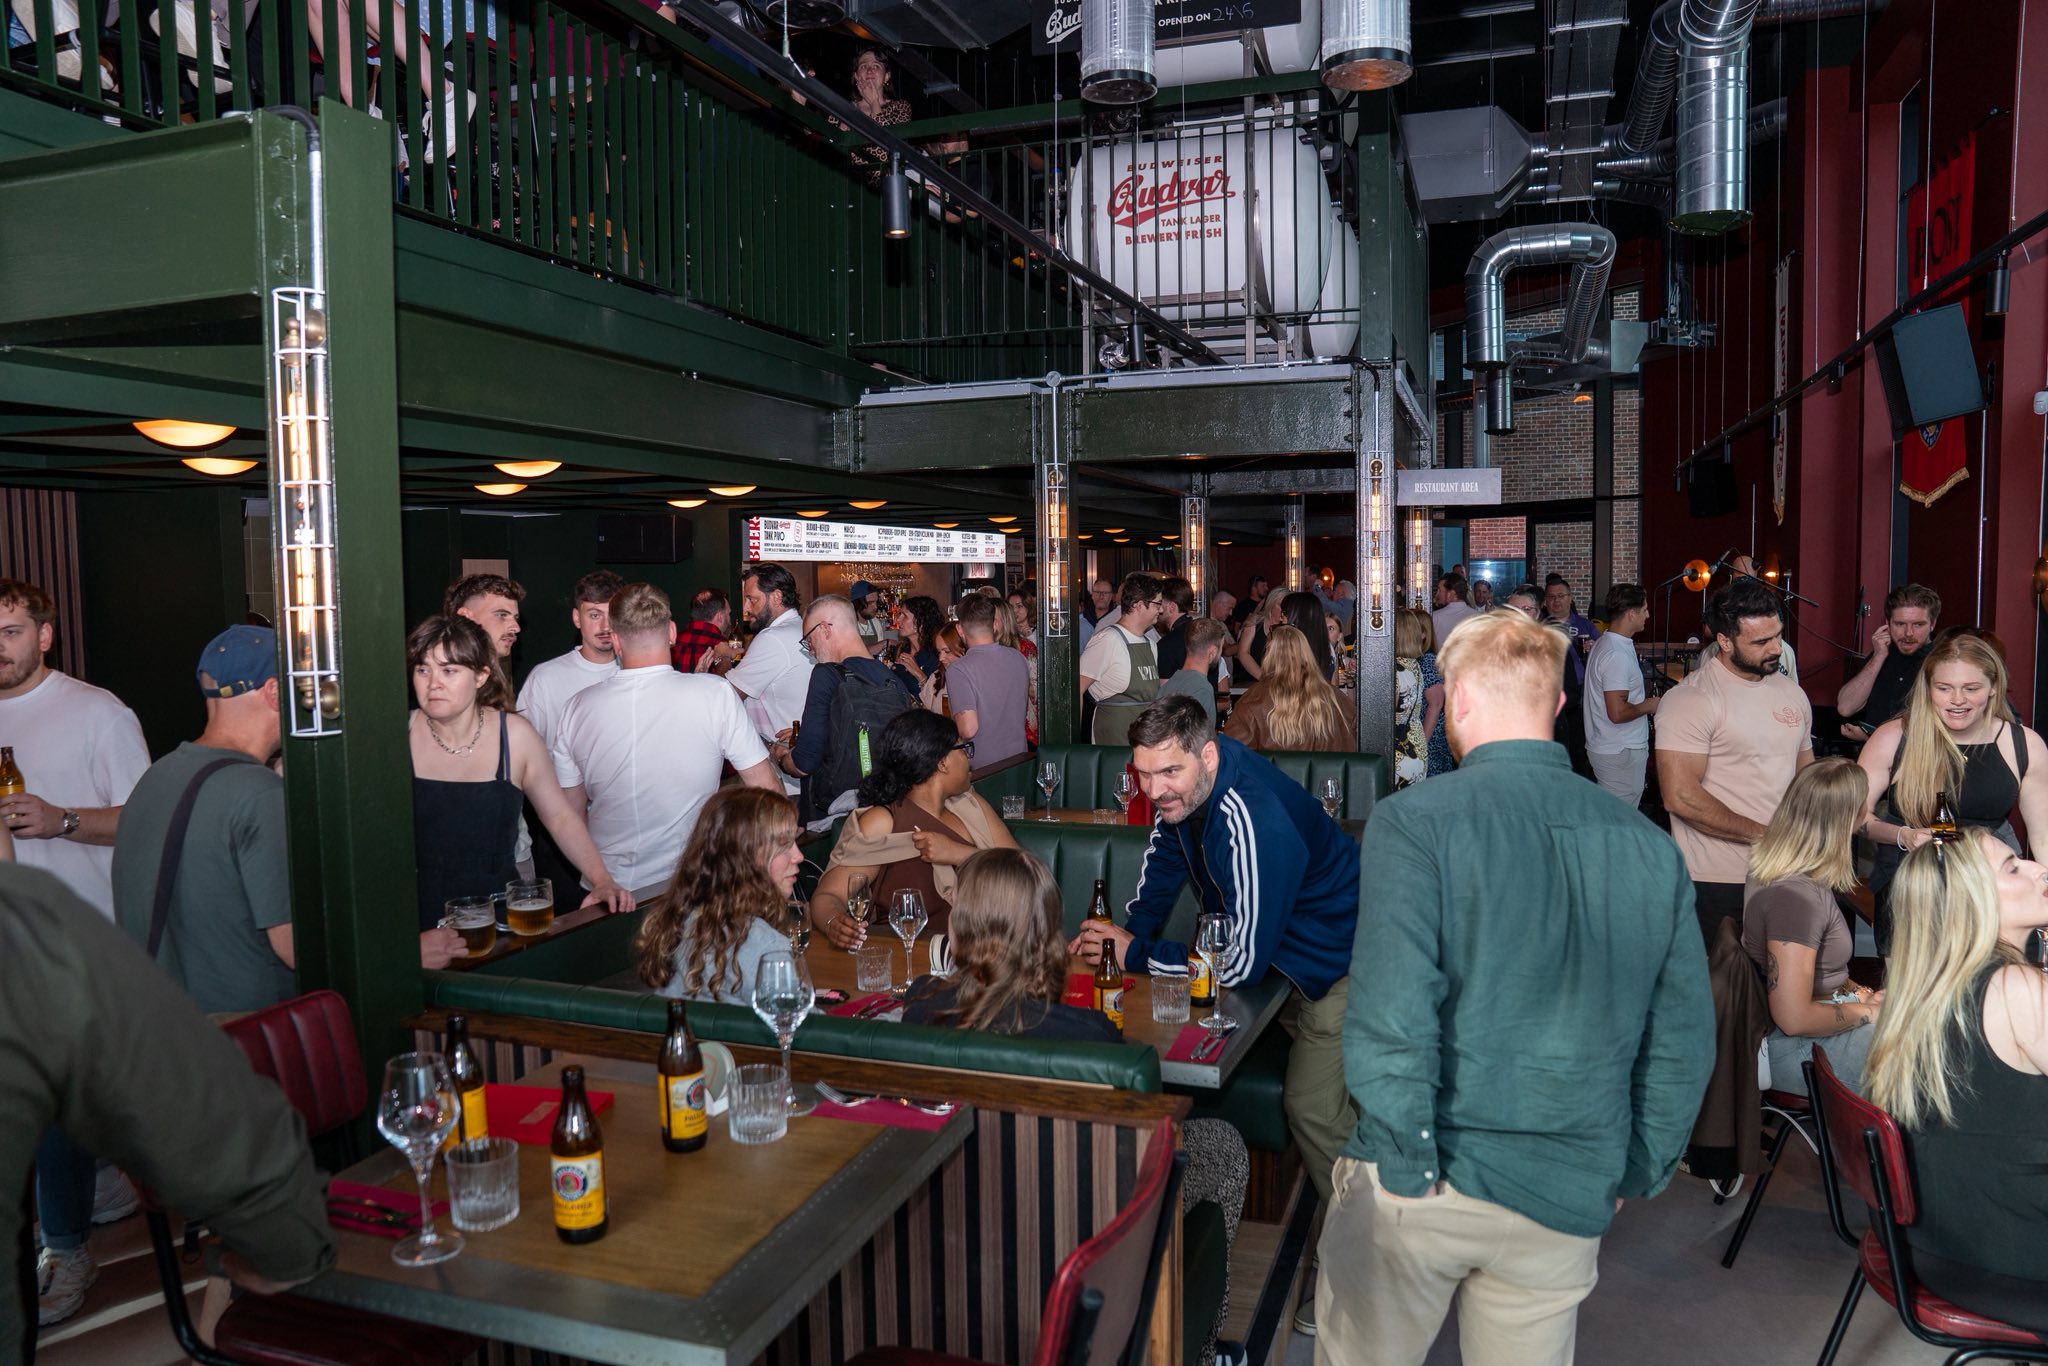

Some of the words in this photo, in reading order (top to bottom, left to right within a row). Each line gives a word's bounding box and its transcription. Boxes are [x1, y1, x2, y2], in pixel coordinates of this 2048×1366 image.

[1158, 15, 1194, 27] OPENED
[1195, 12, 1211, 22] ON
[1126, 155, 1223, 172] BUDWEISER
[1107, 169, 1236, 219] Budvar
[1161, 217, 1187, 227] TANK
[1190, 213, 1222, 224] LAGER
[1414, 483, 1459, 493] RESTAURANT
[1460, 482, 1480, 493] AREA
